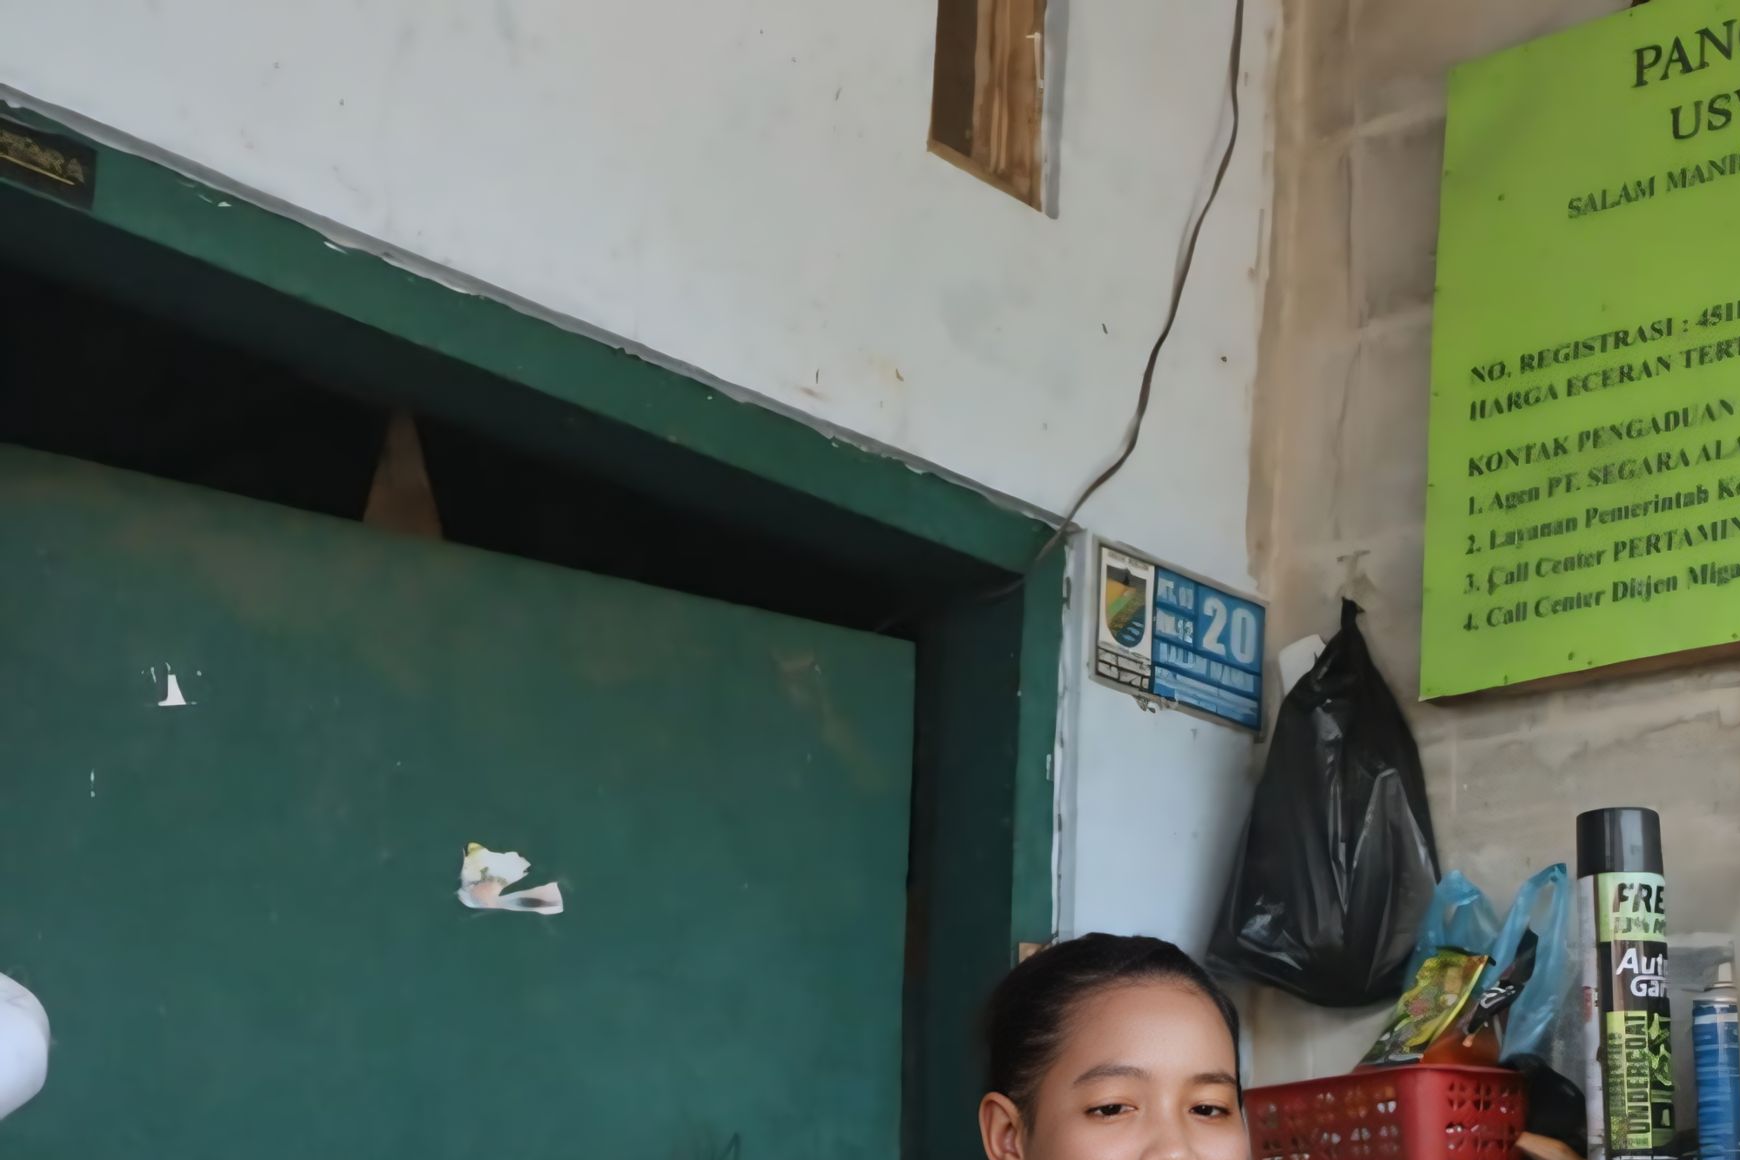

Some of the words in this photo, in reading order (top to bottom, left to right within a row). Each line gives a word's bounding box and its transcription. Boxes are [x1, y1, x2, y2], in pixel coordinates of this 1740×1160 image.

[1567, 175, 1656, 218] SALAM
[1520, 317, 1673, 375] REGISTRASI
[1469, 383, 1559, 421] HARGA
[1566, 354, 1672, 398] ECERAN
[1468, 435, 1569, 477] KONTAK
[1577, 398, 1739, 453] PENGADUAN
[1489, 486, 1541, 512] Agen
[1587, 448, 1691, 488] SEGARA
[1489, 516, 1578, 550] Layanan
[1585, 483, 1709, 529] Pemerintah
[1487, 561, 1530, 596] Call
[1535, 549, 1607, 579] Center
[1202, 596, 1257, 664] 20
[1486, 601, 1528, 628] Call
[1534, 589, 1607, 619] Center
